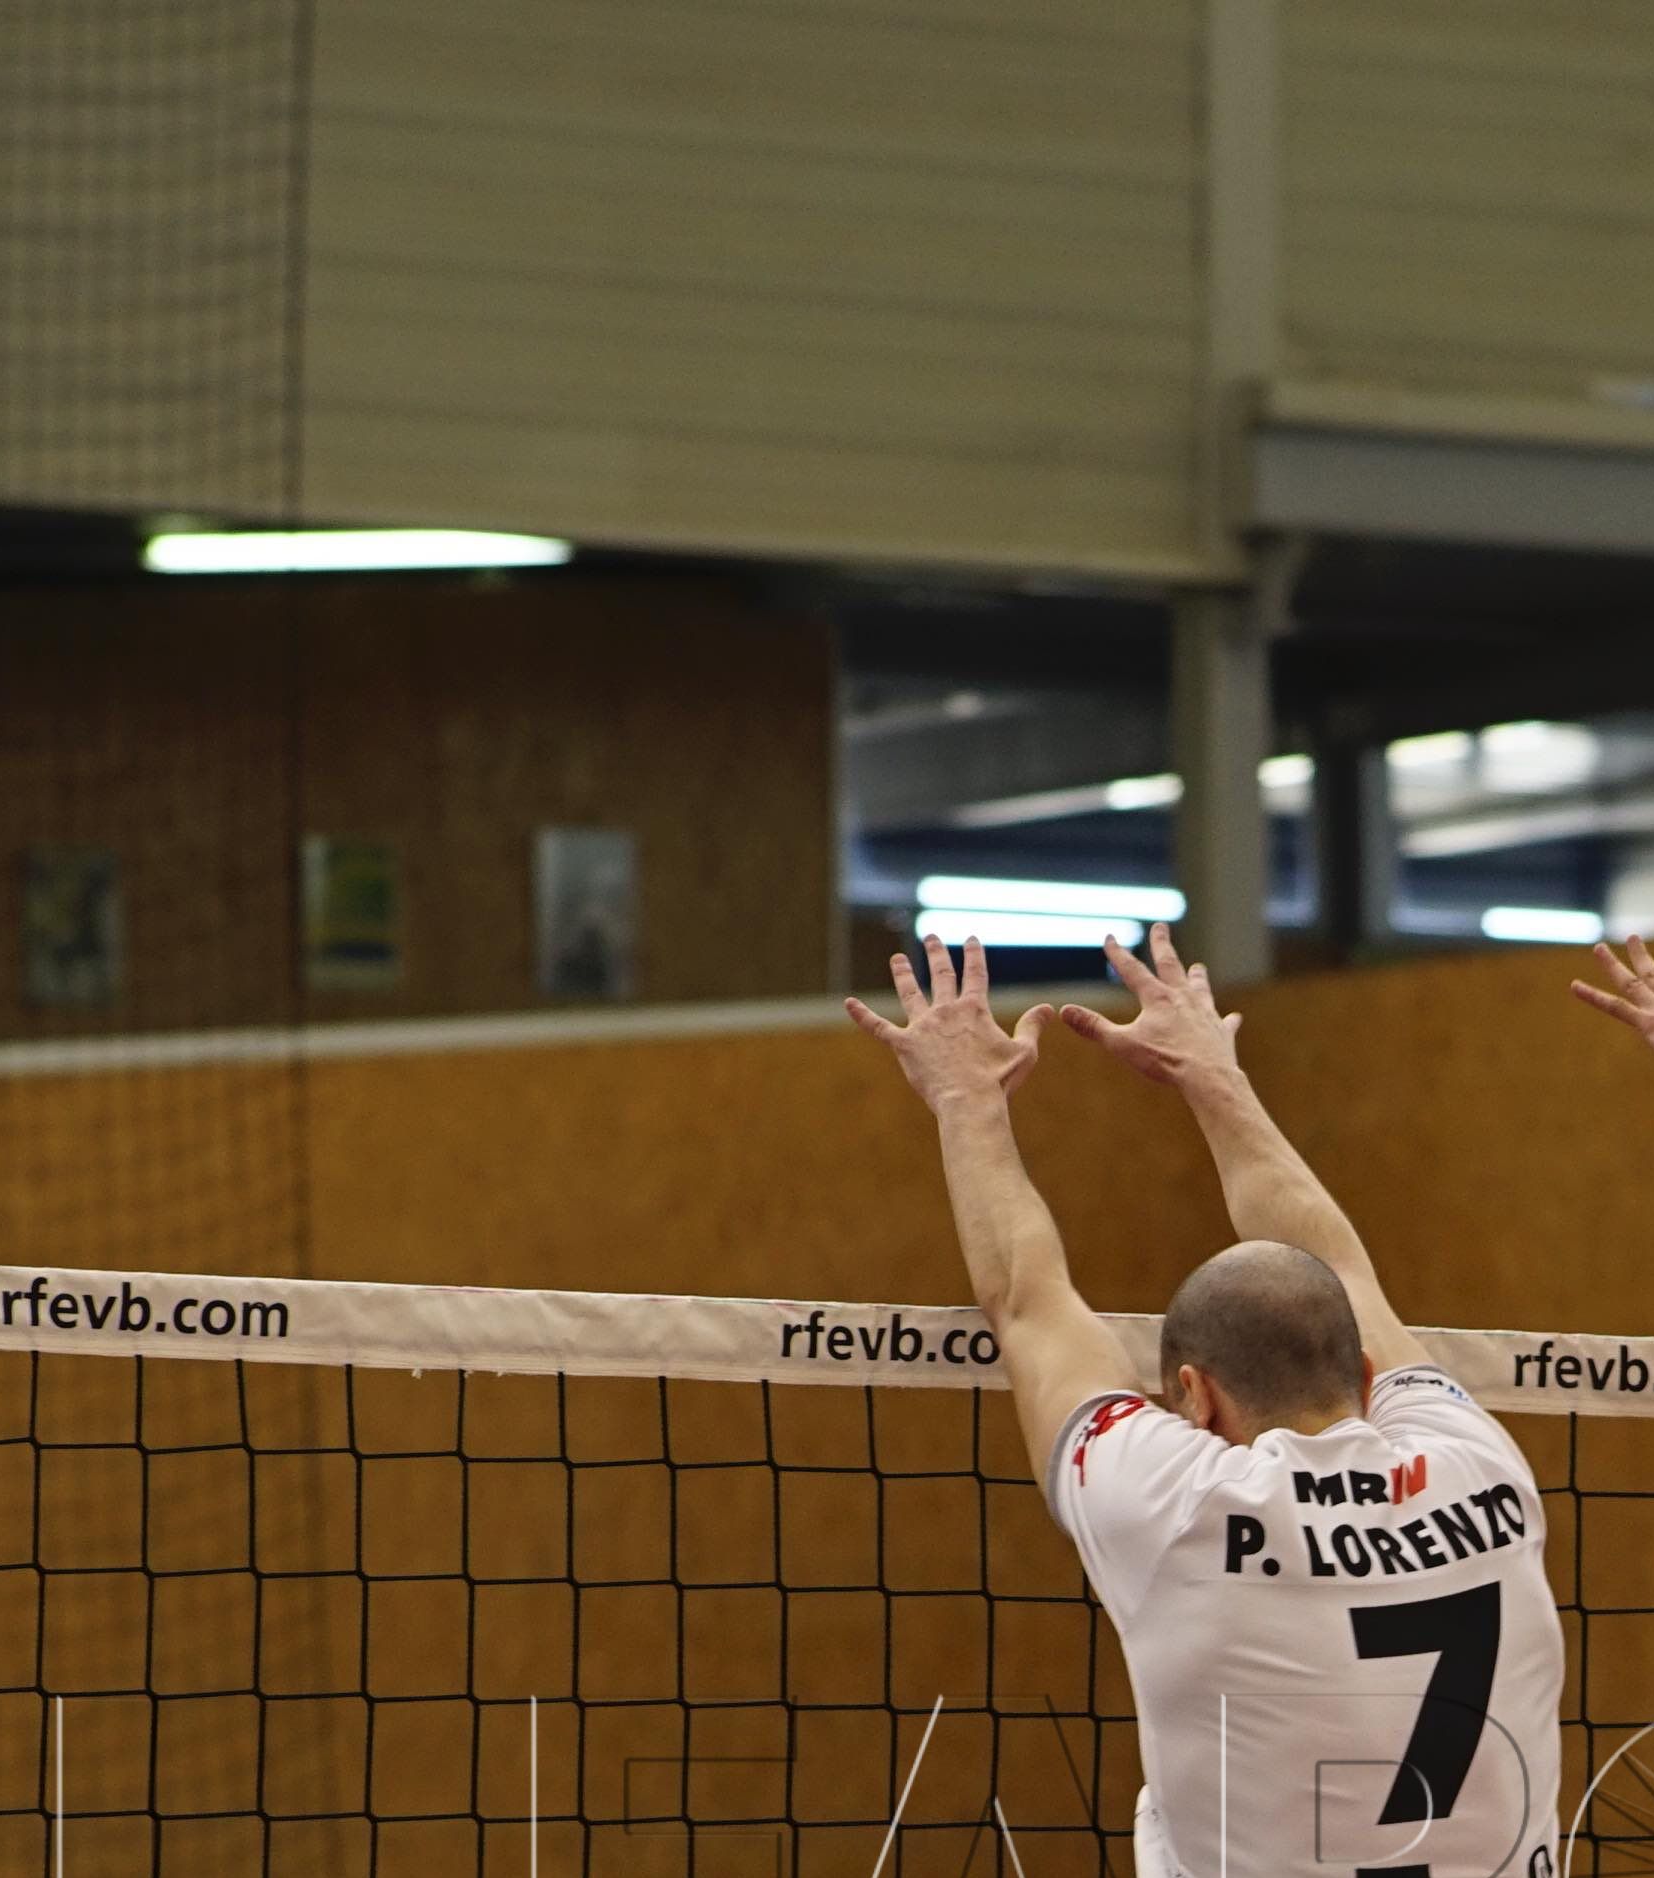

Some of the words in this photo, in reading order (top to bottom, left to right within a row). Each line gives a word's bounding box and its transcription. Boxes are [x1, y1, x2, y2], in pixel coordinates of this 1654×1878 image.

[1, 1276, 289, 1338] rfevb.com
[780, 1310, 1001, 1365] rfevb.co
[1225, 1514, 1281, 1577] P.
[1302, 1482, 1526, 1578] LORENZO
[1349, 1580, 1501, 1825] 7
